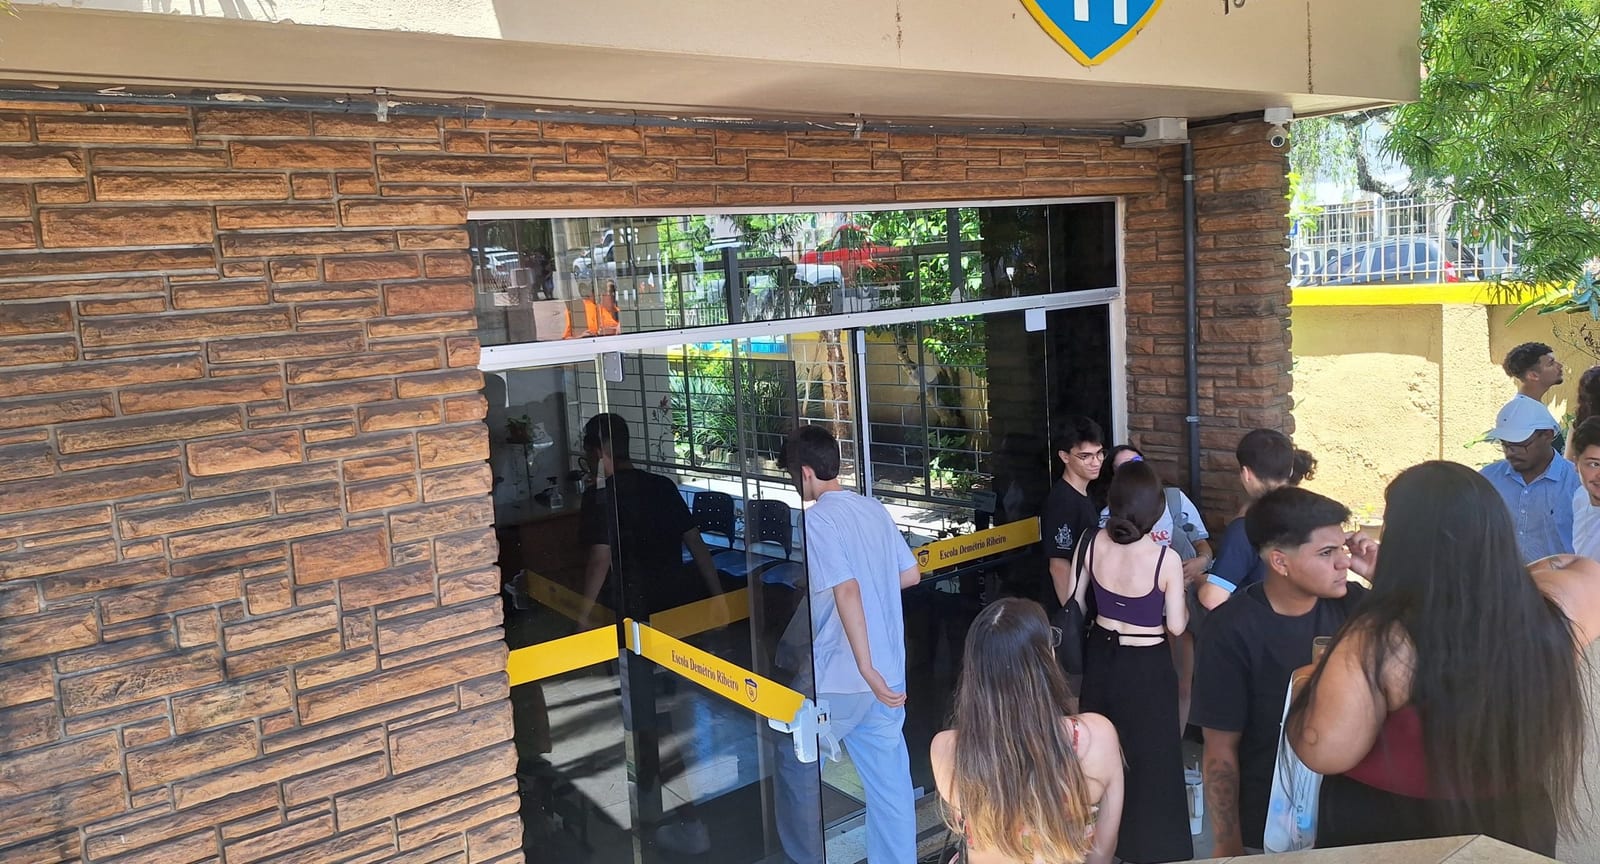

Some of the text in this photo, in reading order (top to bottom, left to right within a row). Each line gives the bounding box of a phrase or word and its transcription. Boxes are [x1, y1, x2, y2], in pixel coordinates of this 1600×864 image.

[940, 548, 958, 560] Escola
[986, 535, 1007, 547] Ribeiro
[671, 649, 689, 668] Escola
[717, 670, 739, 691] Ribeiro
